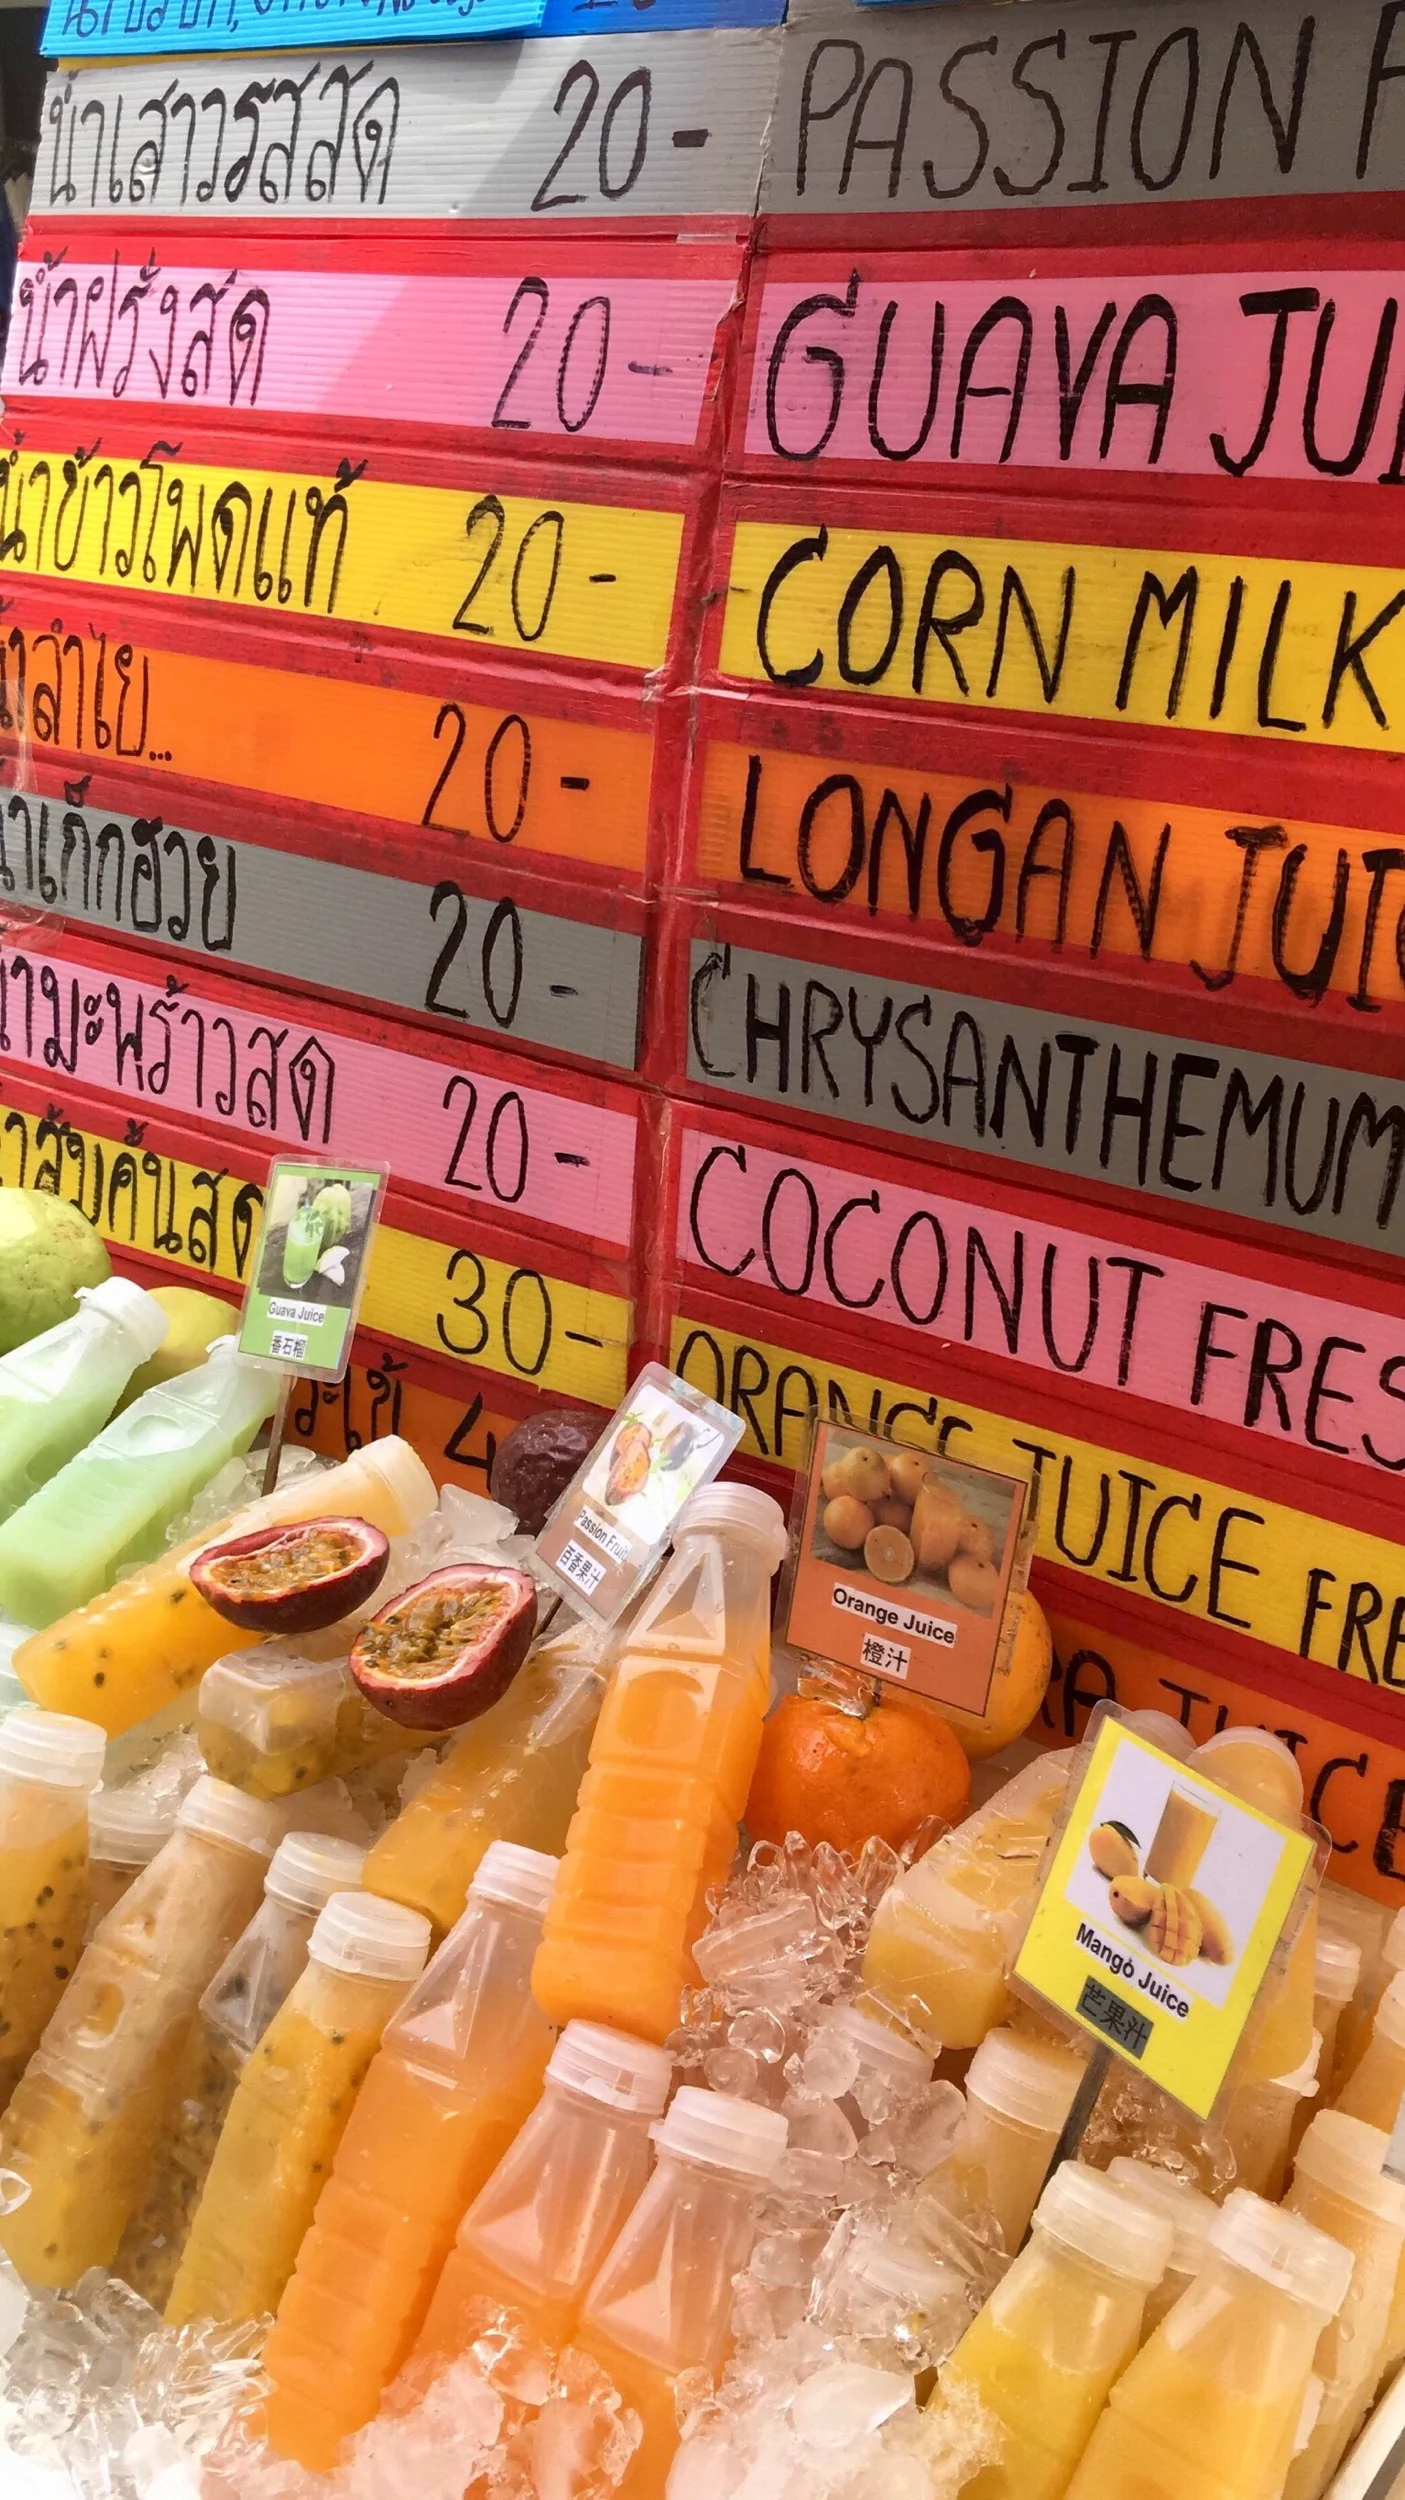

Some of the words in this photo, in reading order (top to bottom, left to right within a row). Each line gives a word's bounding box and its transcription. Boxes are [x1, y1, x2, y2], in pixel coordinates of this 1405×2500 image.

[797, 16, 1314, 198] PASSION
[19, 245, 270, 406] น้ำฝรั่งสด
[766, 268, 1177, 463] GUAVA
[756, 524, 1075, 704] CORN
[1116, 565, 1405, 731] MILK
[740, 754, 1172, 963] LONGAN
[1189, 825, 1405, 1012] JUI
[691, 942, 1405, 1229] CHRYSANTHEMUM
[268, 1301, 297, 1319] Guava
[297, 1306, 325, 1323] Juice
[690, 1144, 1164, 1387] COCONUT
[560, 1544, 601, 1590] 百香果汁
[575, 1509, 608, 1545] Passion
[605, 1534, 630, 1562] Fruit
[832, 1587, 899, 1625] Orange
[903, 1614, 956, 1644] Juice
[862, 1638, 908, 1672] 橙汁
[1075, 1922, 1135, 1978] Mango
[1138, 1972, 1190, 2018] Juice
[1081, 1984, 1148, 2050] 芒果汁
